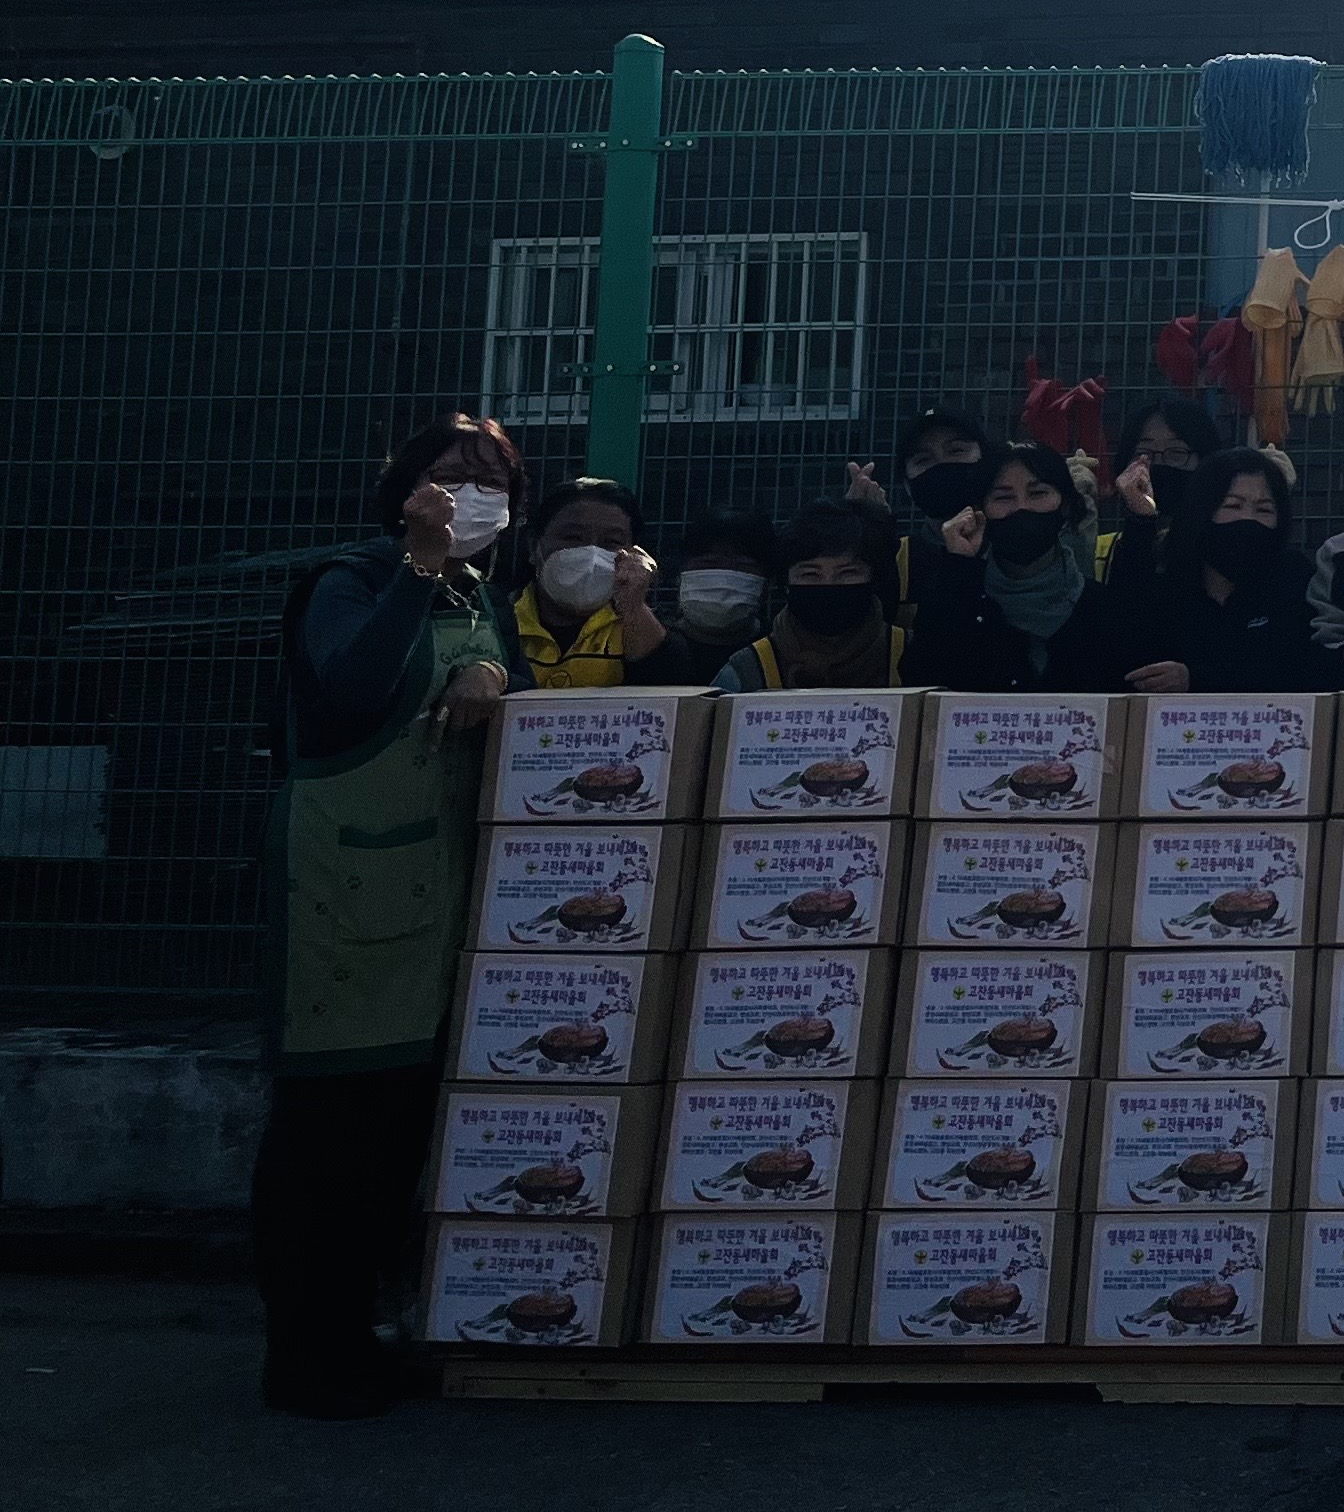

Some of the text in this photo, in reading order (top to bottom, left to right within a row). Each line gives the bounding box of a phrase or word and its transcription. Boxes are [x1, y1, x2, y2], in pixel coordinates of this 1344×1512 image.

[553, 732, 621, 748] 고잔동새마을회
[768, 857, 834, 872] 고잔동새마을회
[1189, 857, 1254, 872] 고잔동새마을회
[967, 985, 1034, 1000] 고잔동새마을회
[1175, 987, 1241, 1003] 고잔동새마을회
[946, 1115, 1014, 1130] 고잔동새마을회
[1156, 1116, 1223, 1132] 고잔동새마을회
[929, 1248, 997, 1265] 고잔동새마을회
[1145, 1248, 1213, 1265] 고잔동새마을회
